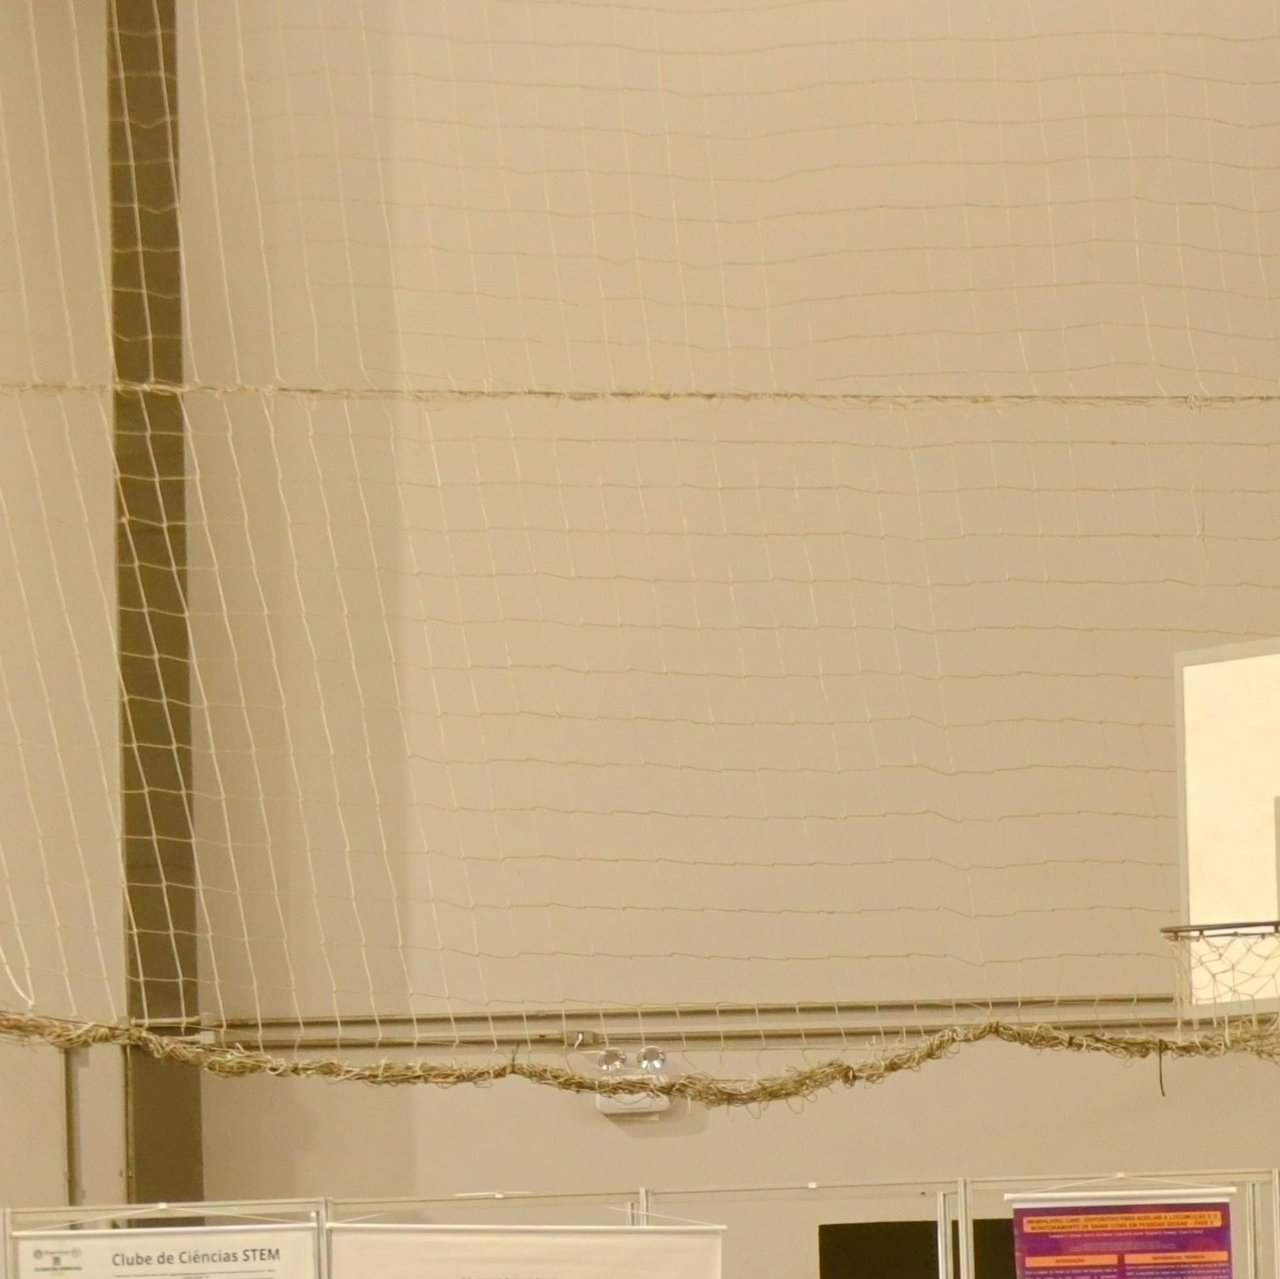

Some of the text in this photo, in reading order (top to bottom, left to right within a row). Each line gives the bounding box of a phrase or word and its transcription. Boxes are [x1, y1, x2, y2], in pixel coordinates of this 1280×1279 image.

[112, 1248, 280, 1267] Clube de Ciências STEM
